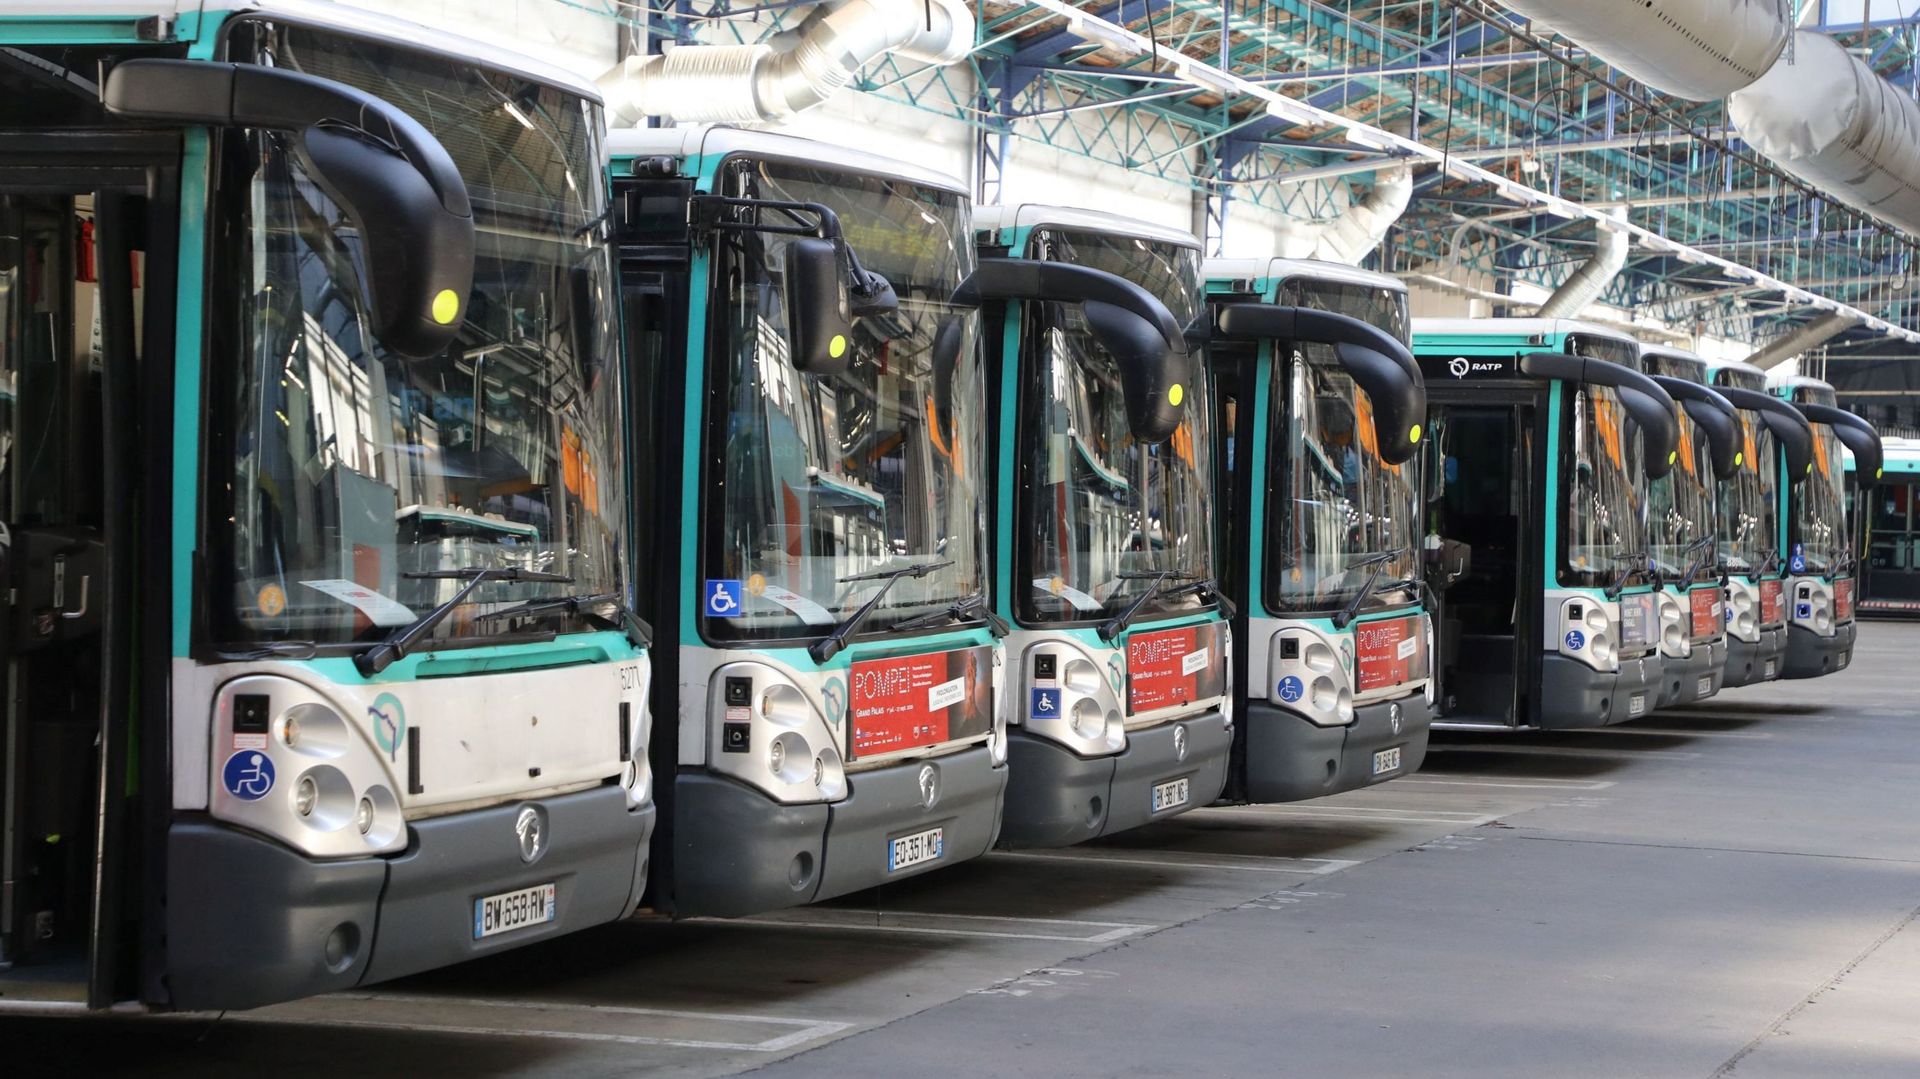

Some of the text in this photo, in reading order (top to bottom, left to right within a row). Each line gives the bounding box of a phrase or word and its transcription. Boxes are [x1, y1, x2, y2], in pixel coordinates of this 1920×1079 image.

[1132, 638, 1171, 666] POMPEI
[1360, 627, 1390, 650] POMPEI
[620, 665, 641, 690] 5277
[855, 666, 910, 700] POMPEI
[485, 889, 546, 931] BW-658-RW
